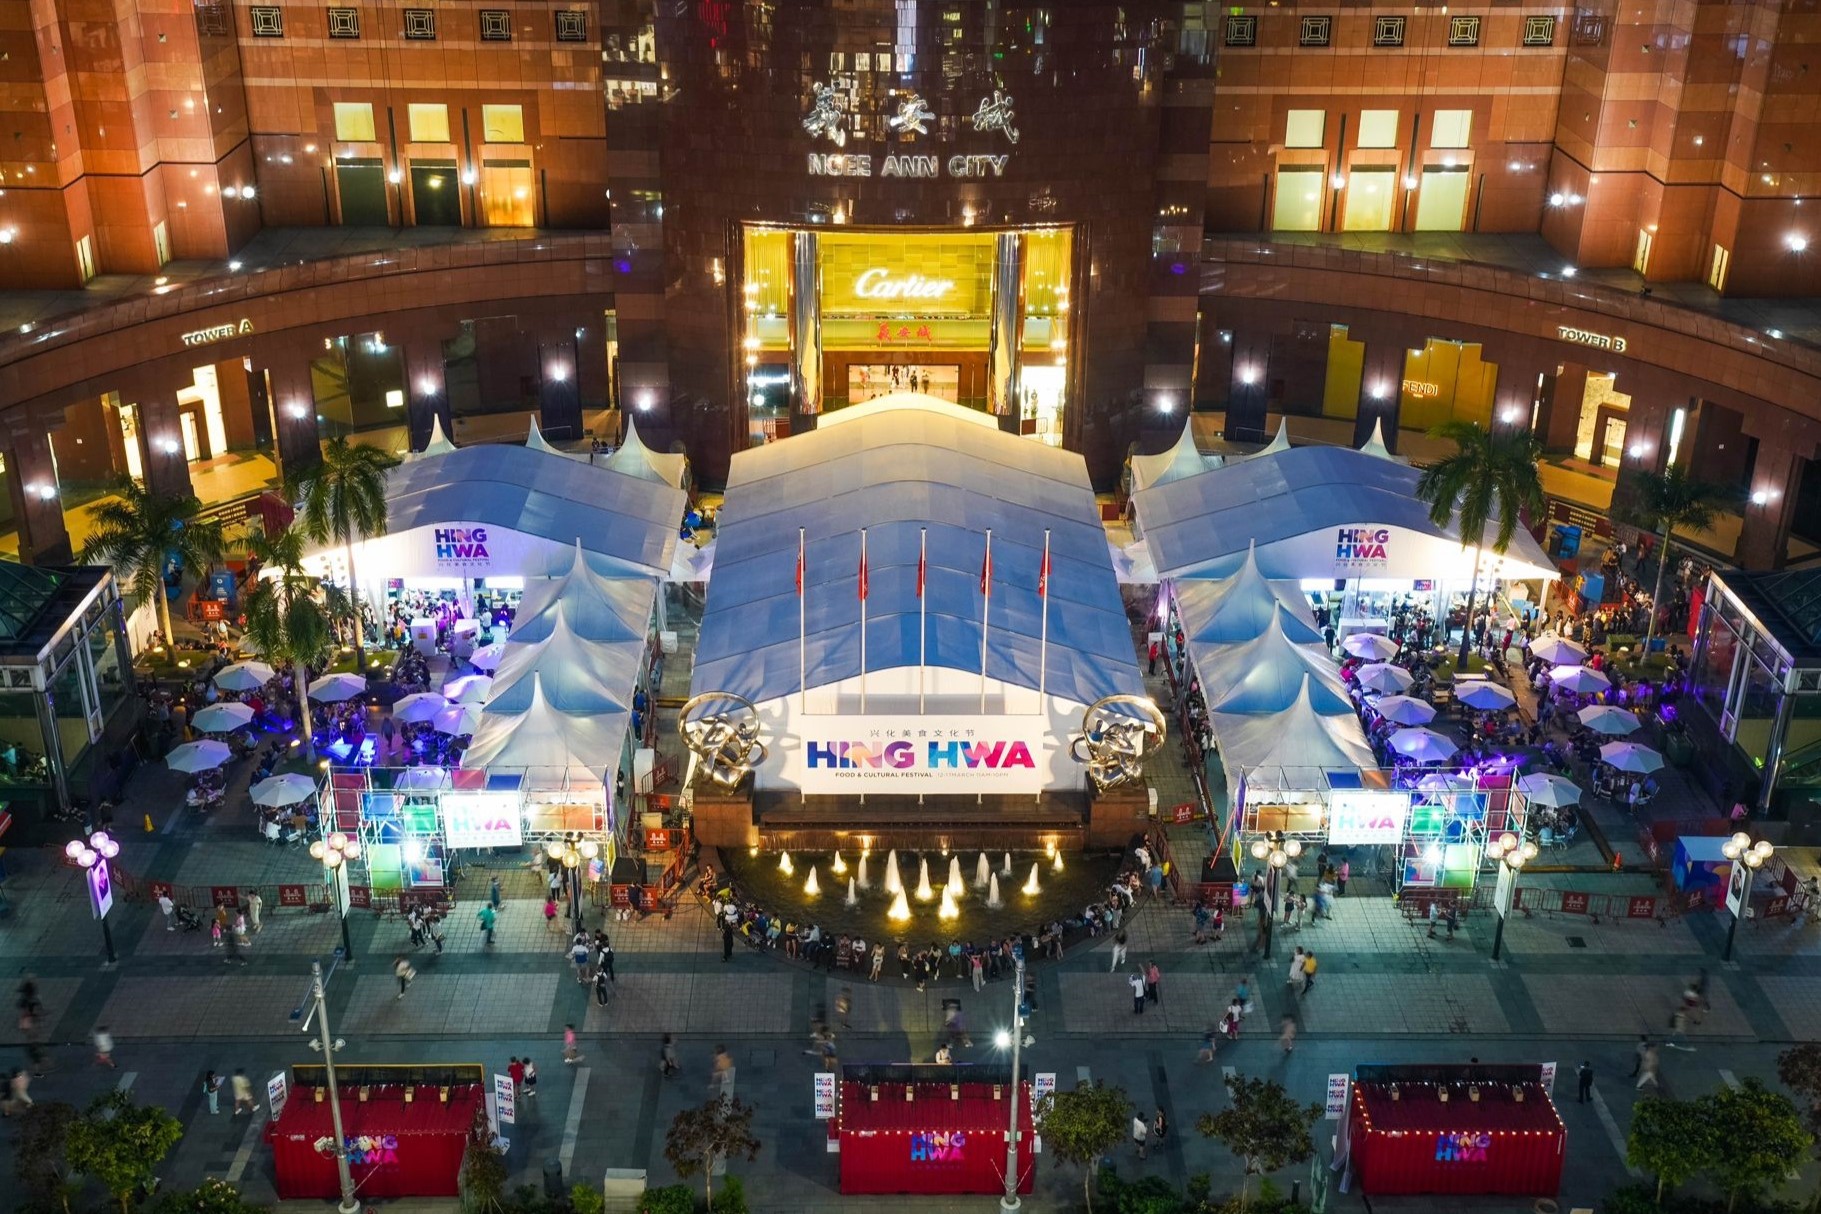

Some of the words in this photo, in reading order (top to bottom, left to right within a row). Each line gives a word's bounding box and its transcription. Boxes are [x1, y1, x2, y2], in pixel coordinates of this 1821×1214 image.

[808, 153, 871, 177] NGEE
[880, 154, 939, 178] ANN
[948, 153, 1009, 177] CITY
[855, 267, 955, 298] Cartier
[181, 324, 236, 346] TOWER
[239, 318, 254, 334] A
[1558, 326, 1611, 349] TOWER
[1612, 336, 1627, 352] B
[1402, 380, 1438, 396] FENDI
[435, 528, 487, 543] HING
[1338, 529, 1389, 543] HING
[437, 544, 489, 558] HWA
[1336, 544, 1387, 558] HWA
[807, 741, 915, 769] HING
[928, 741, 1036, 768] HWA
[910, 1133, 966, 1147] HING
[1437, 1134, 1491, 1148] HING
[345, 1149, 399, 1164] HWA
[911, 1148, 965, 1161] HWA
[1435, 1148, 1488, 1161] HWA
